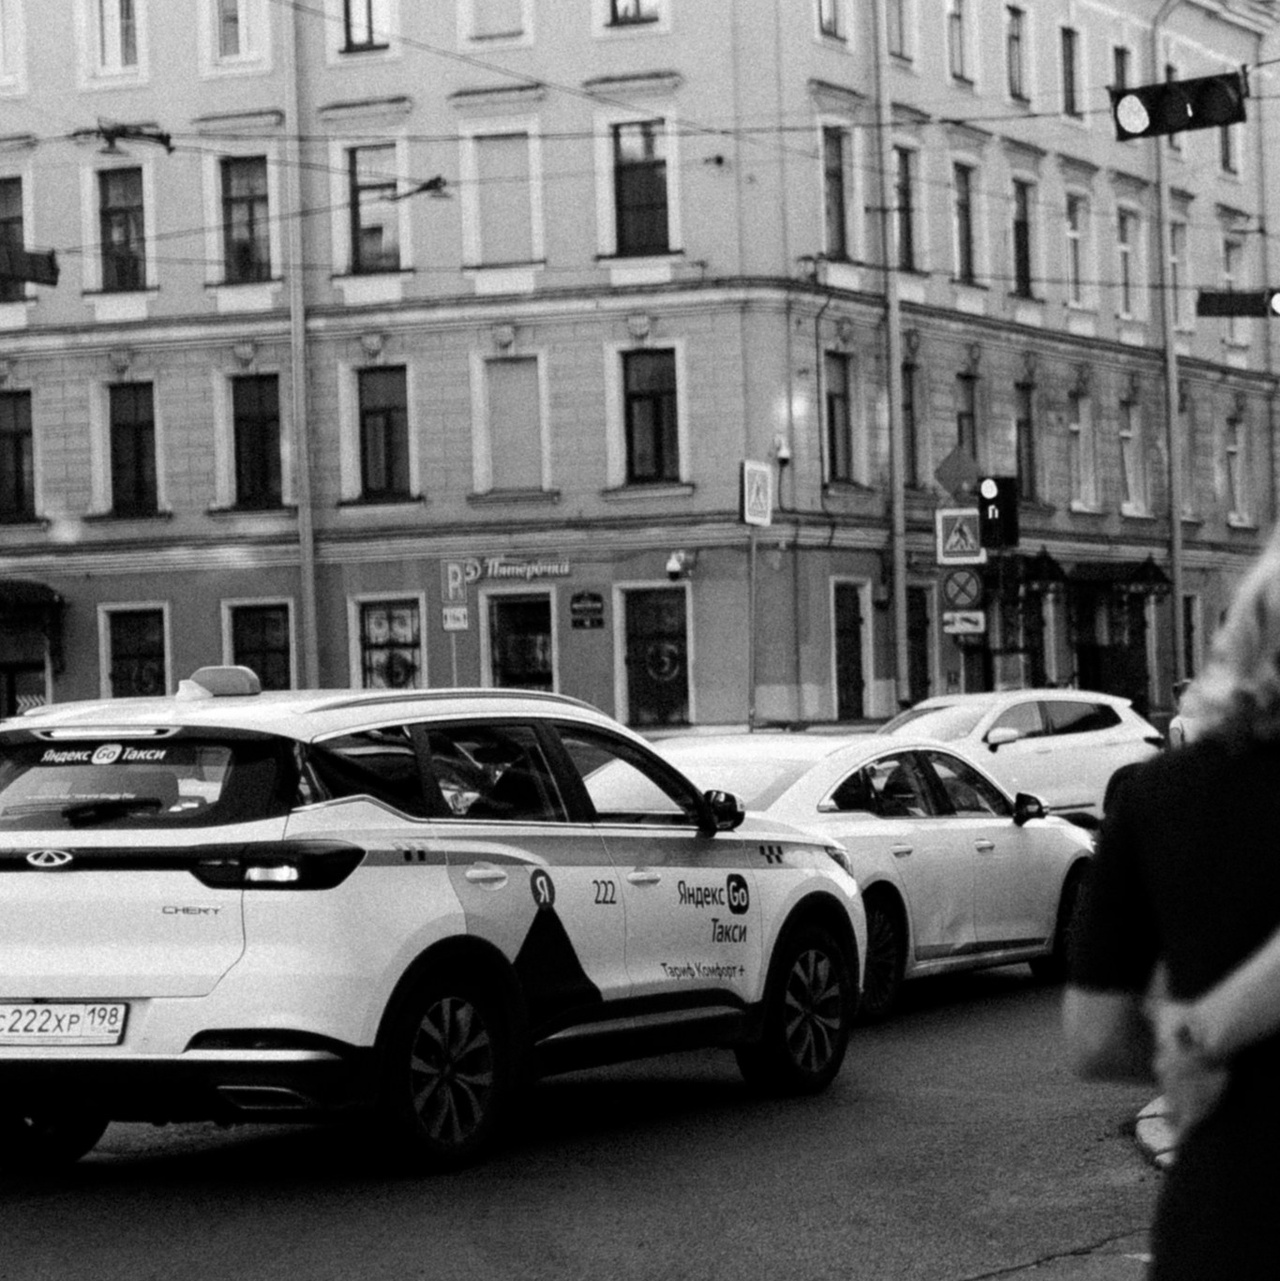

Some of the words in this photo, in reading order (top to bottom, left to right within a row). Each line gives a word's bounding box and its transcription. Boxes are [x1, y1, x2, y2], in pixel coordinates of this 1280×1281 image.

[41, 749, 91, 763] Яндекс
[97, 747, 116, 760] Go
[122, 747, 166, 760] Такси
[536, 876, 550, 903] Я
[592, 880, 617, 904] 222
[678, 880, 725, 909] Яндекс
[729, 881, 747, 907] Go
[711, 918, 747, 943] Такси
[660, 963, 696, 980] Тариф
[88, 1006, 119, 1026] 198
